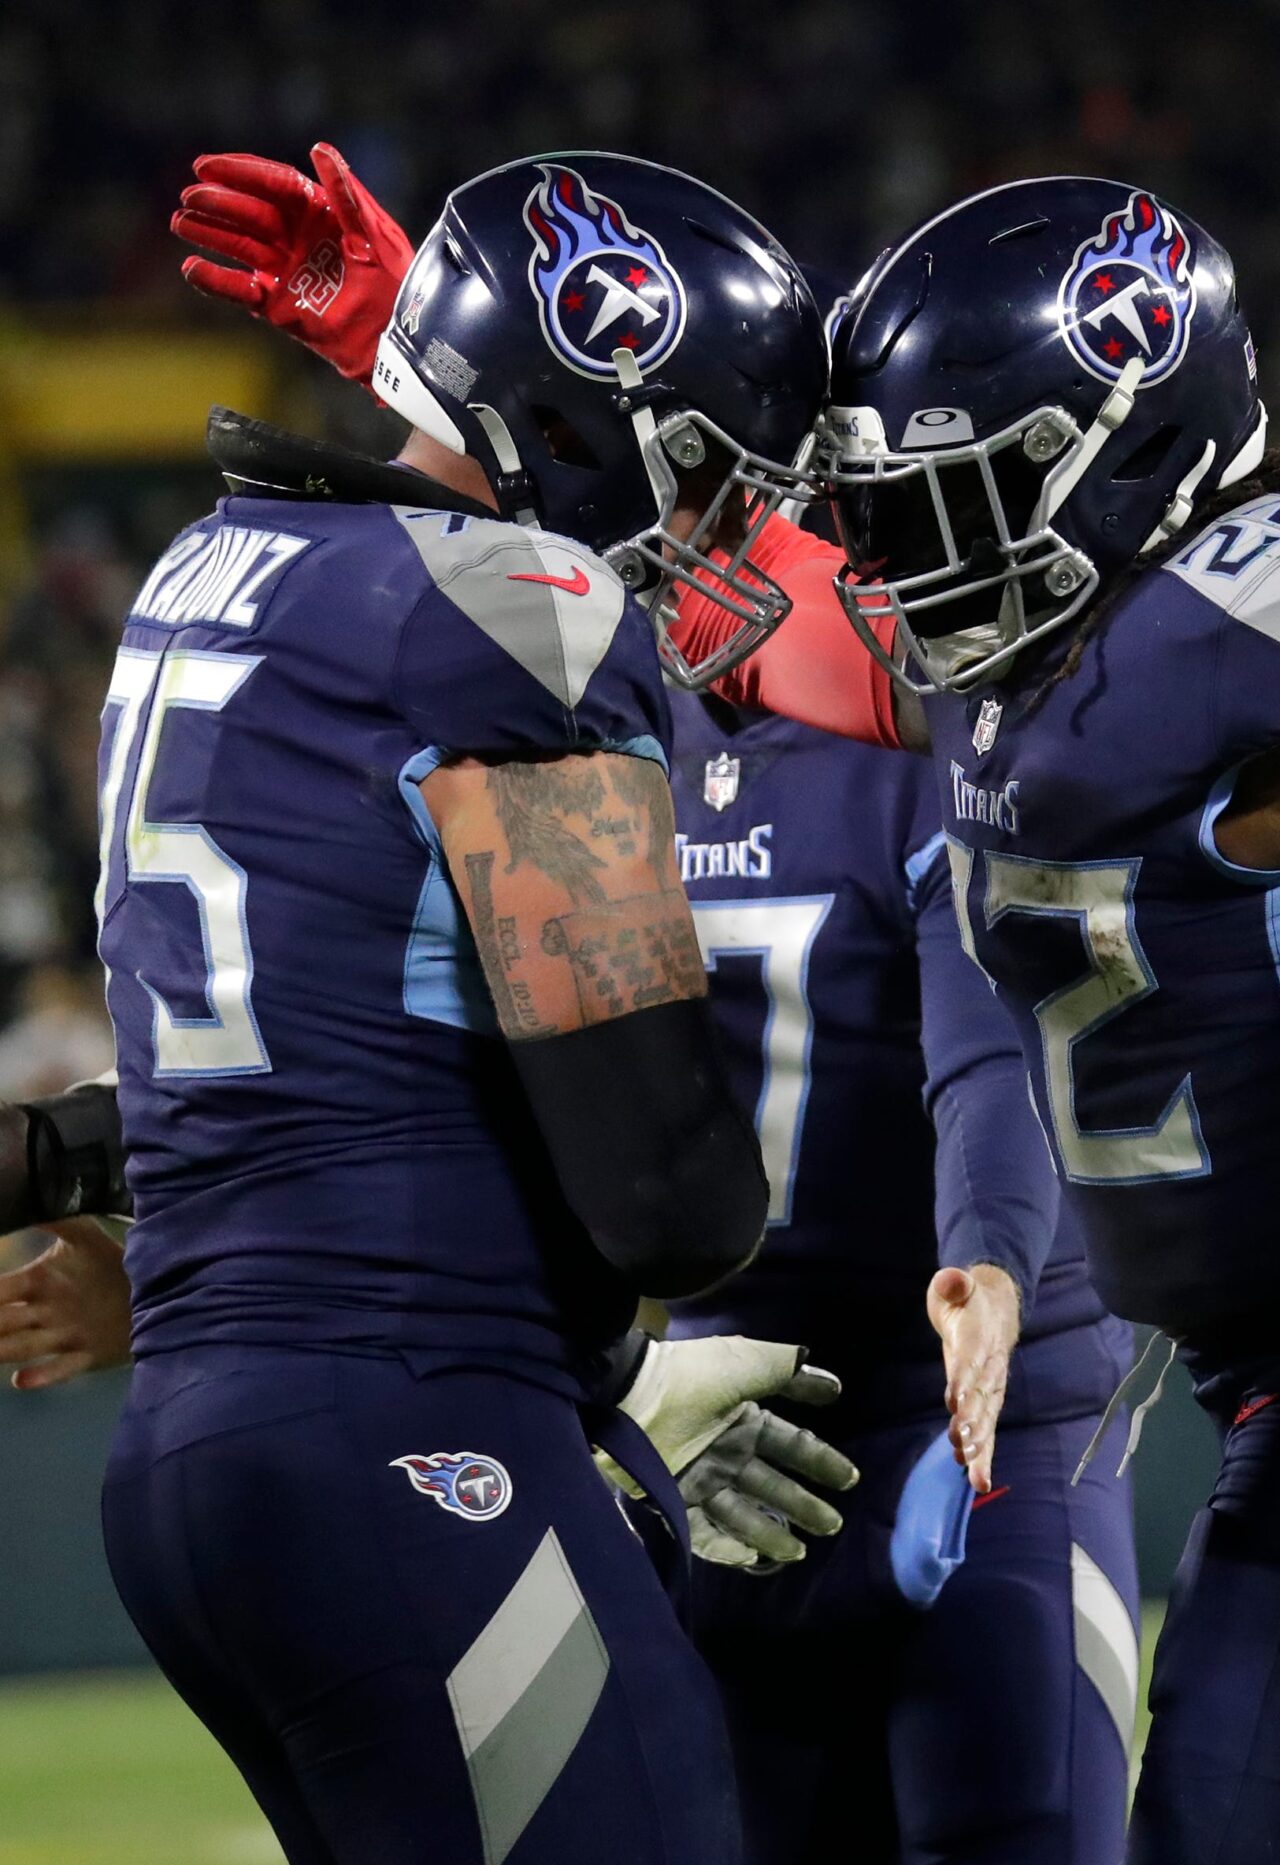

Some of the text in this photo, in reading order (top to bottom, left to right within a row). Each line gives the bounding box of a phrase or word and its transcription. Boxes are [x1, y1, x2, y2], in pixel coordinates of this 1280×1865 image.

[130, 526, 312, 628] RADUNZ
[950, 759, 1021, 836] TITANS
[946, 835, 1212, 1185] 2
